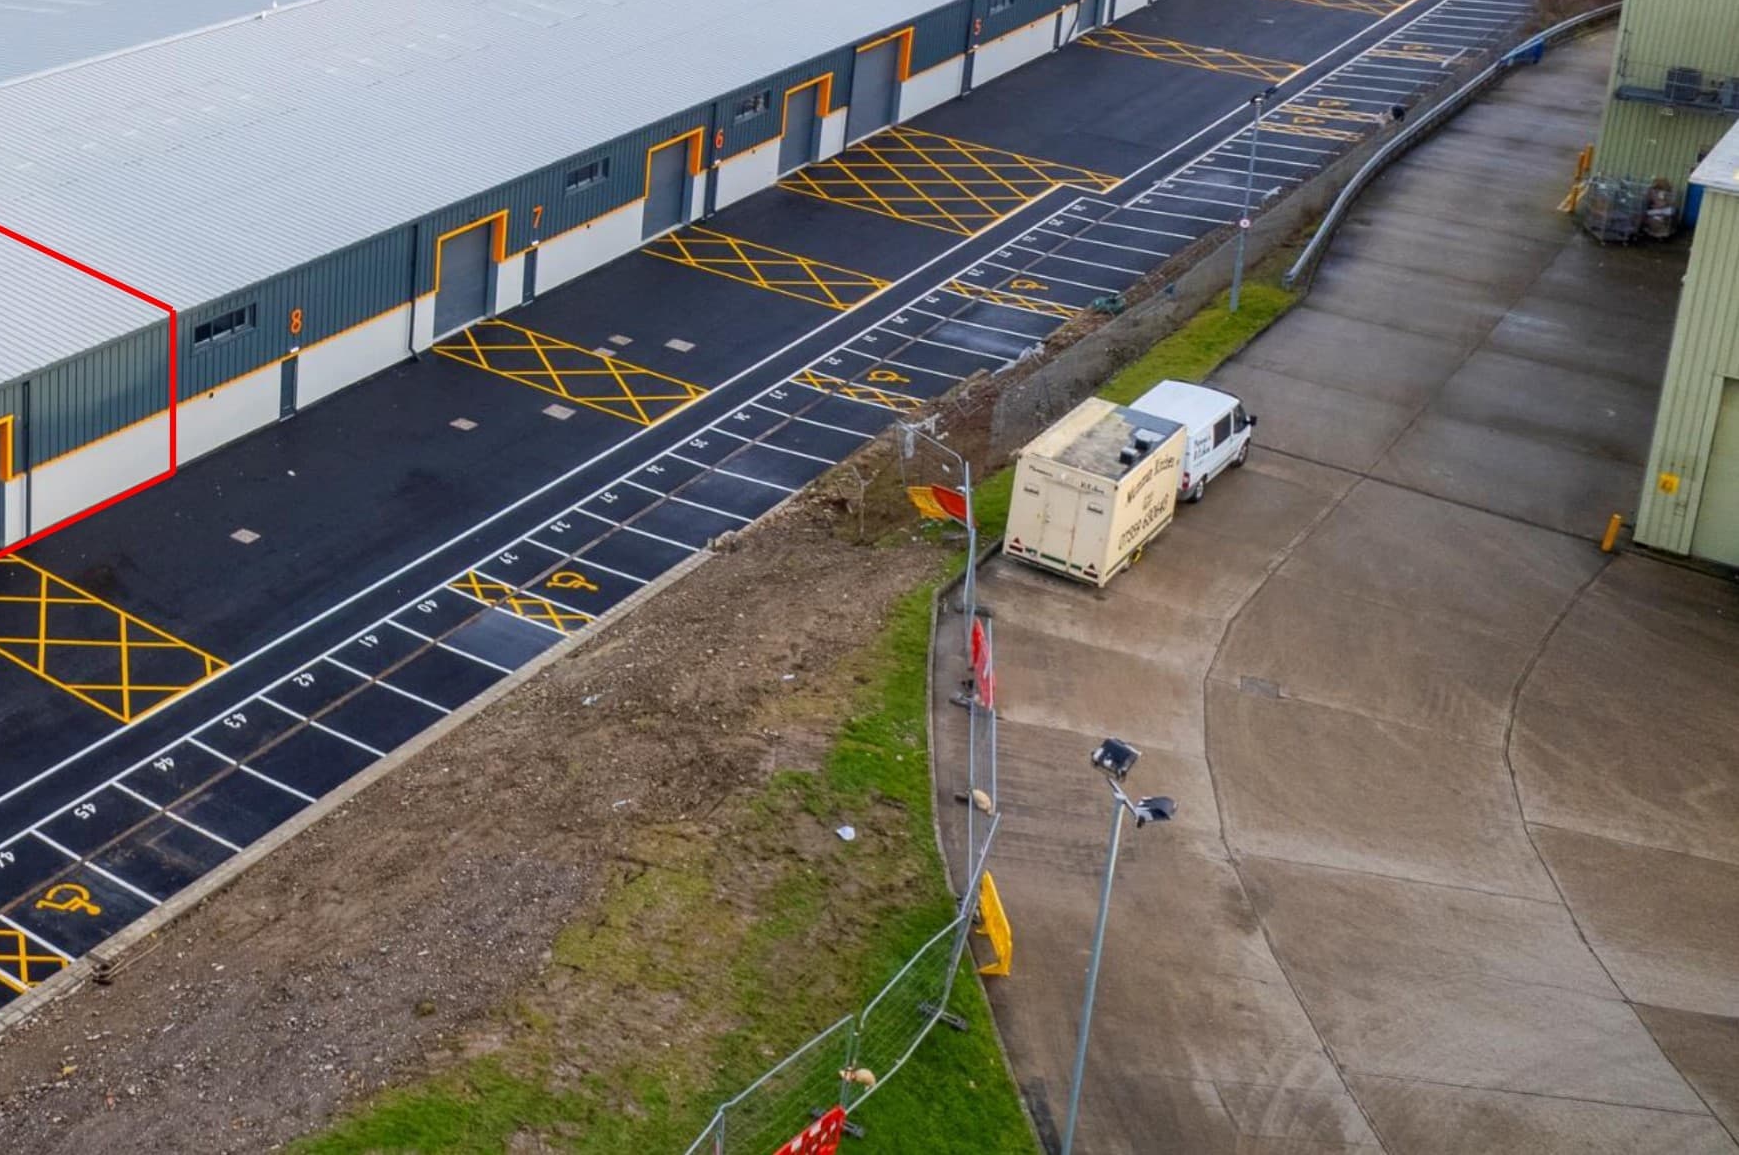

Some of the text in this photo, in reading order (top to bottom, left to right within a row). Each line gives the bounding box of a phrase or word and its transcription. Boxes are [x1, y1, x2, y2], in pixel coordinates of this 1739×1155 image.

[716, 129, 724, 149] 6
[533, 205, 543, 228] 7
[290, 309, 302, 333] 8
[417, 599, 438, 613] 40
[358, 634, 379, 647] 41
[293, 672, 314, 687] 42
[224, 713, 247, 728] 43
[153, 757, 175, 771] 44
[74, 803, 97, 820] 45
